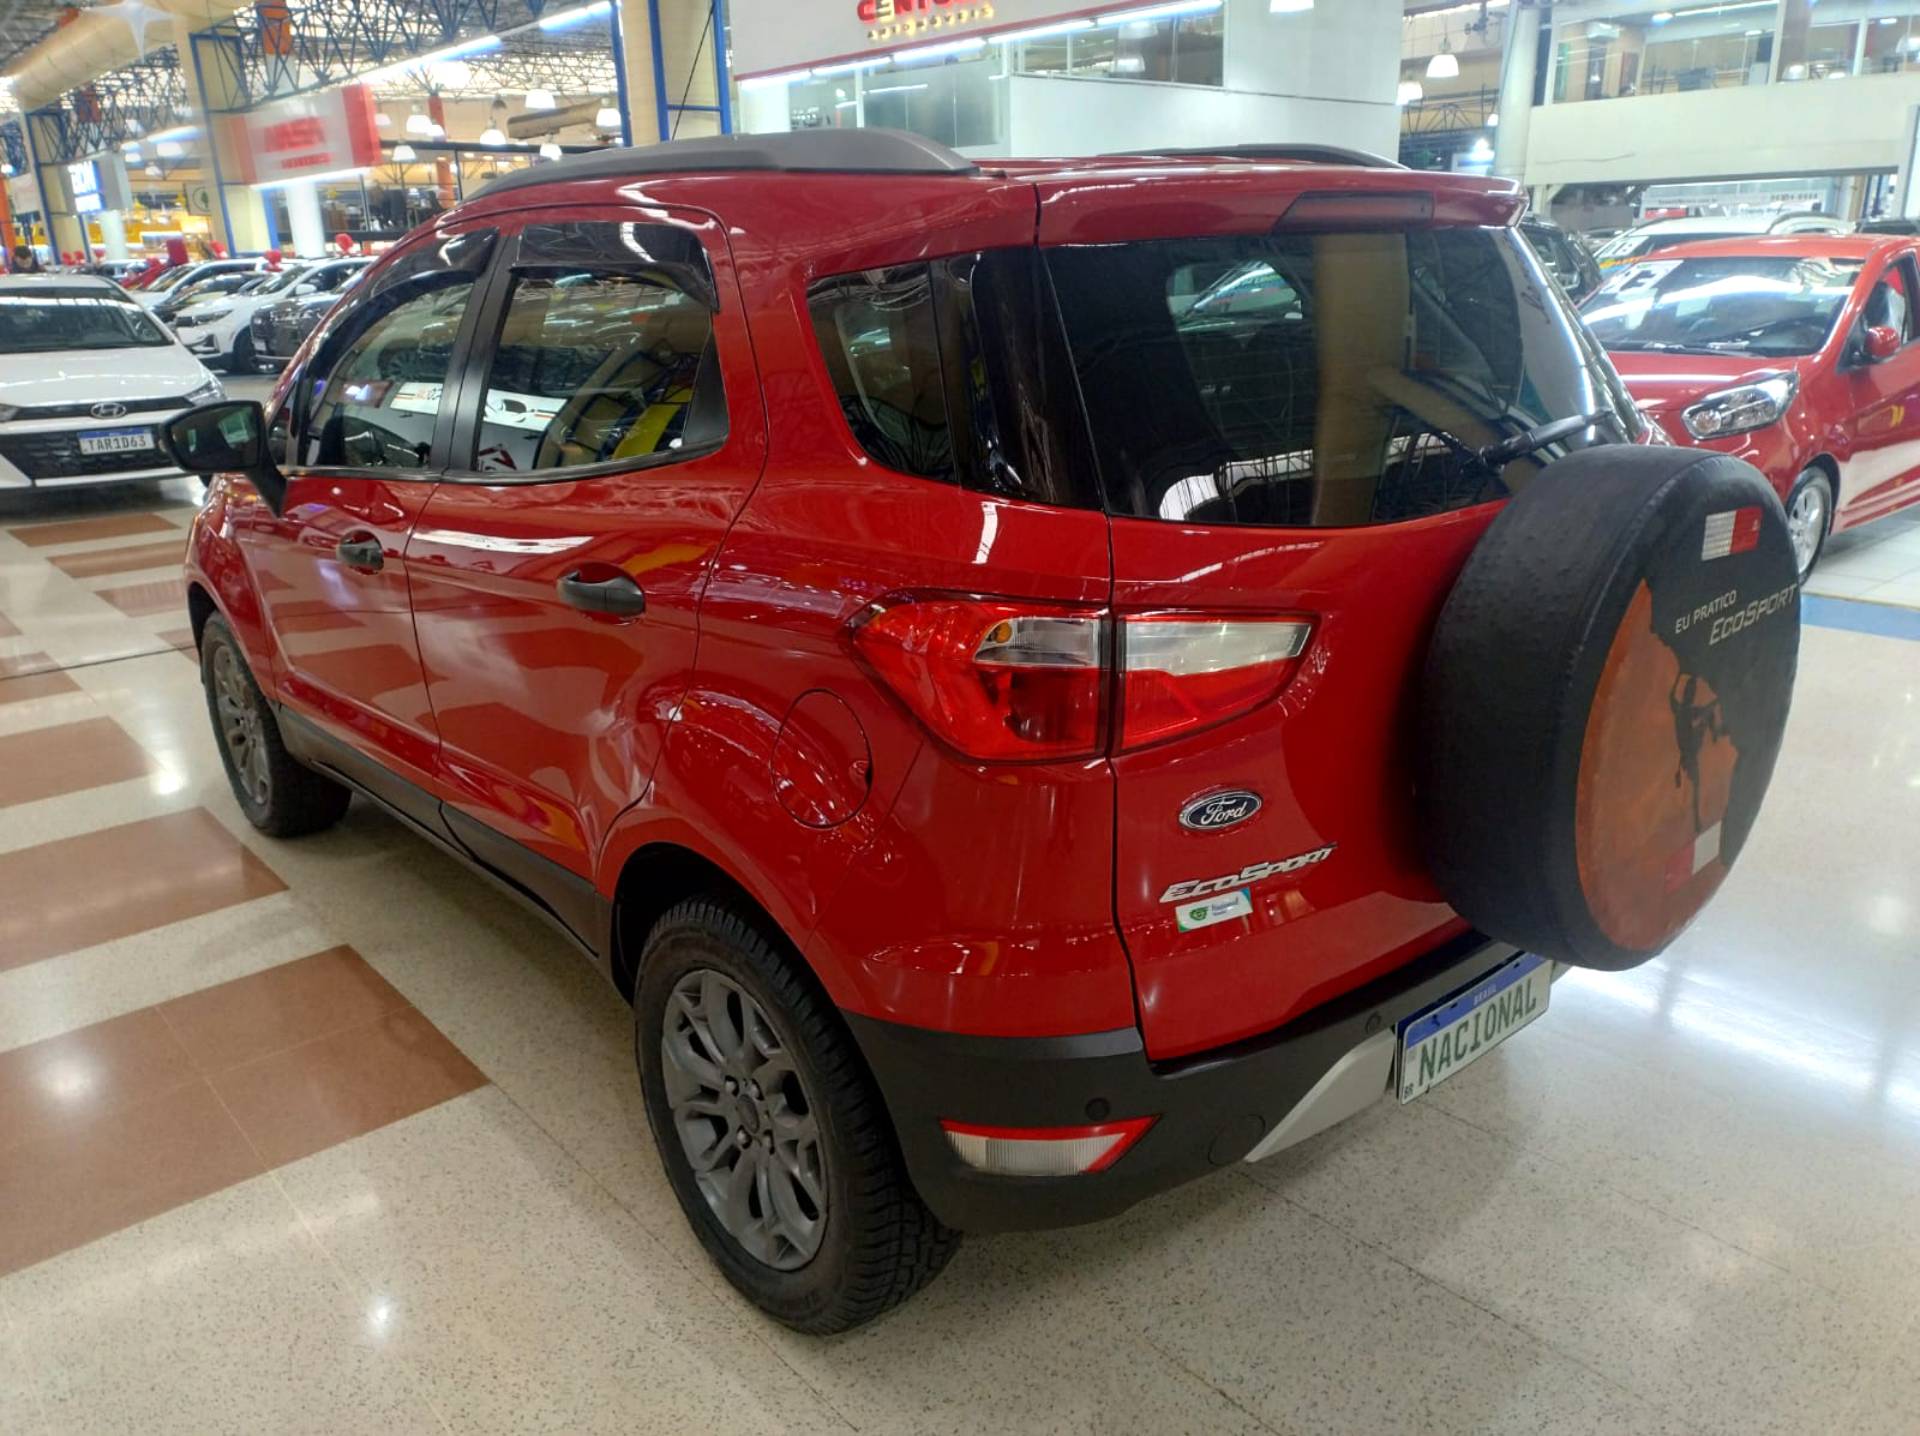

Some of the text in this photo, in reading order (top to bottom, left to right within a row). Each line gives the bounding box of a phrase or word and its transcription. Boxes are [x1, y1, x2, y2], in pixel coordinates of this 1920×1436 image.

[1675, 614, 1691, 634] EU
[1709, 584, 1798, 646] ECOSPORT
[1200, 797, 1247, 825] Ford
[1418, 978, 1537, 1086] NACIONAL
